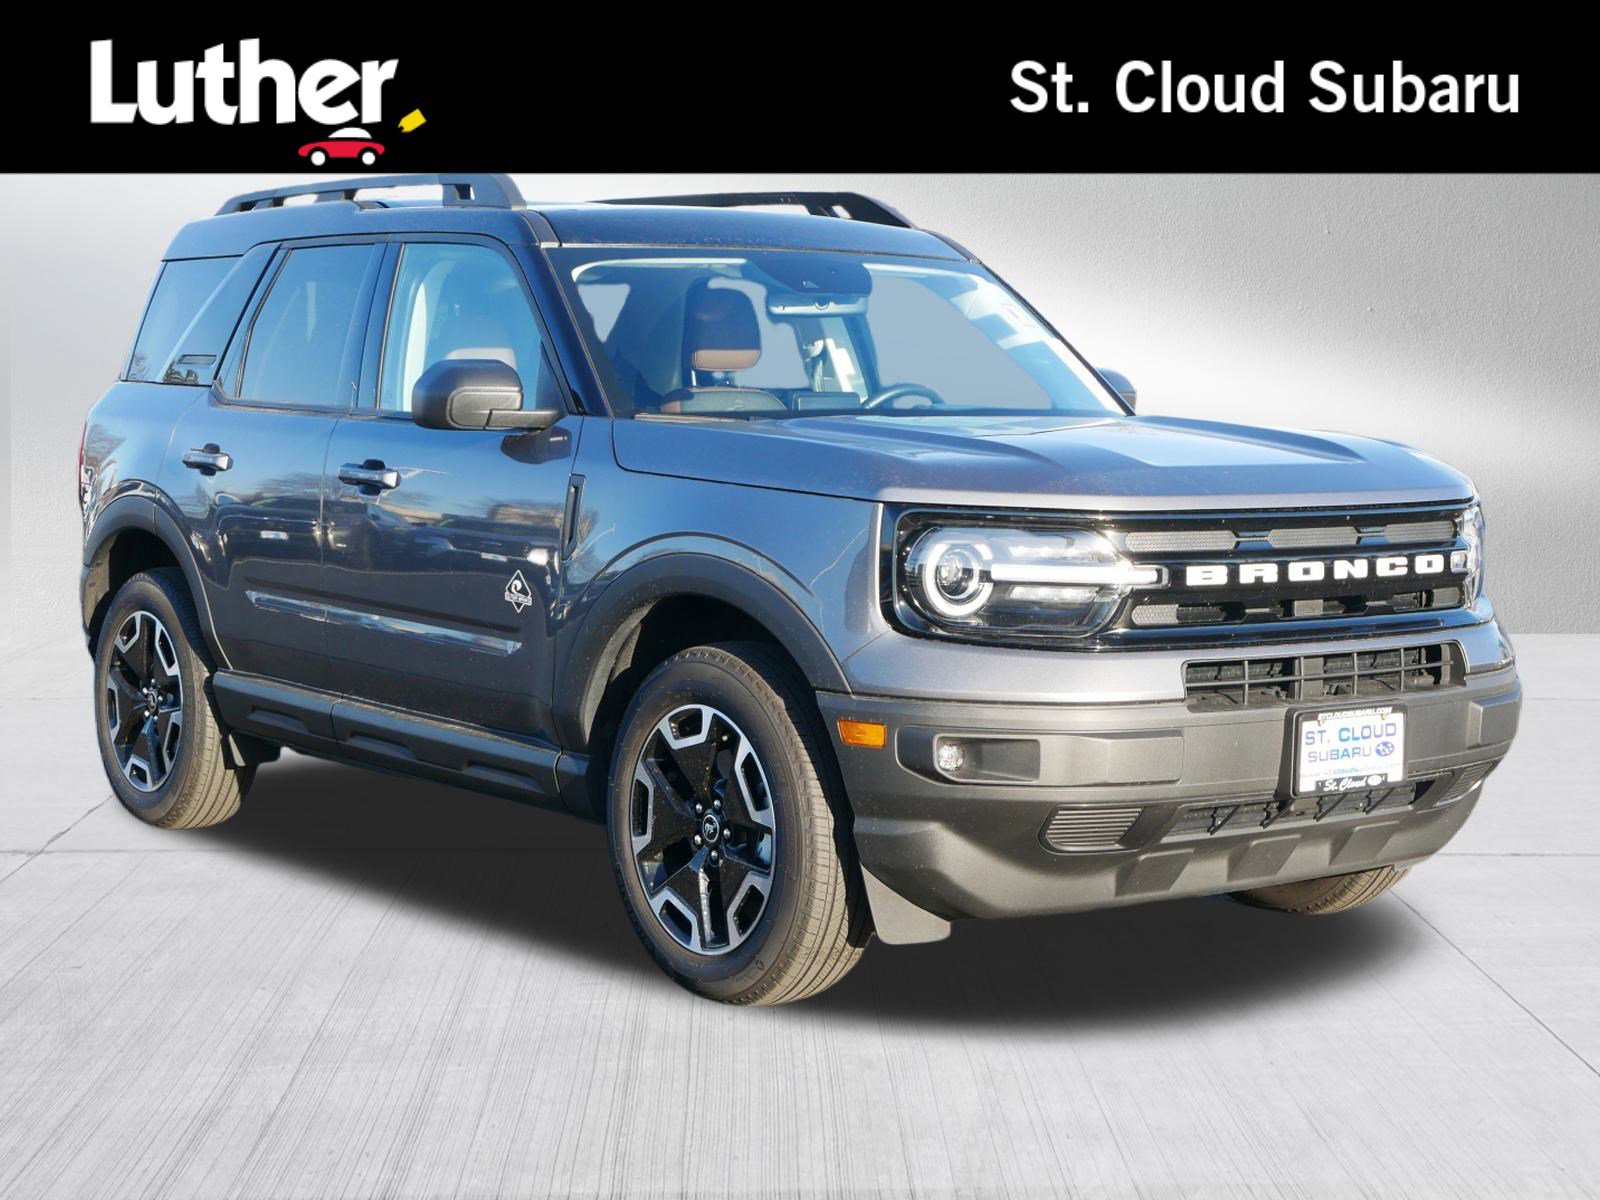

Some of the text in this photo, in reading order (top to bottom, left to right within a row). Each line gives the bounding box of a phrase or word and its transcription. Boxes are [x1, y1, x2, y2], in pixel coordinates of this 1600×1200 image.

[1185, 553, 1445, 587] BRONCO
[1305, 722, 1397, 746] ST. CLOUD
[1307, 745, 1372, 763] SUBARU
